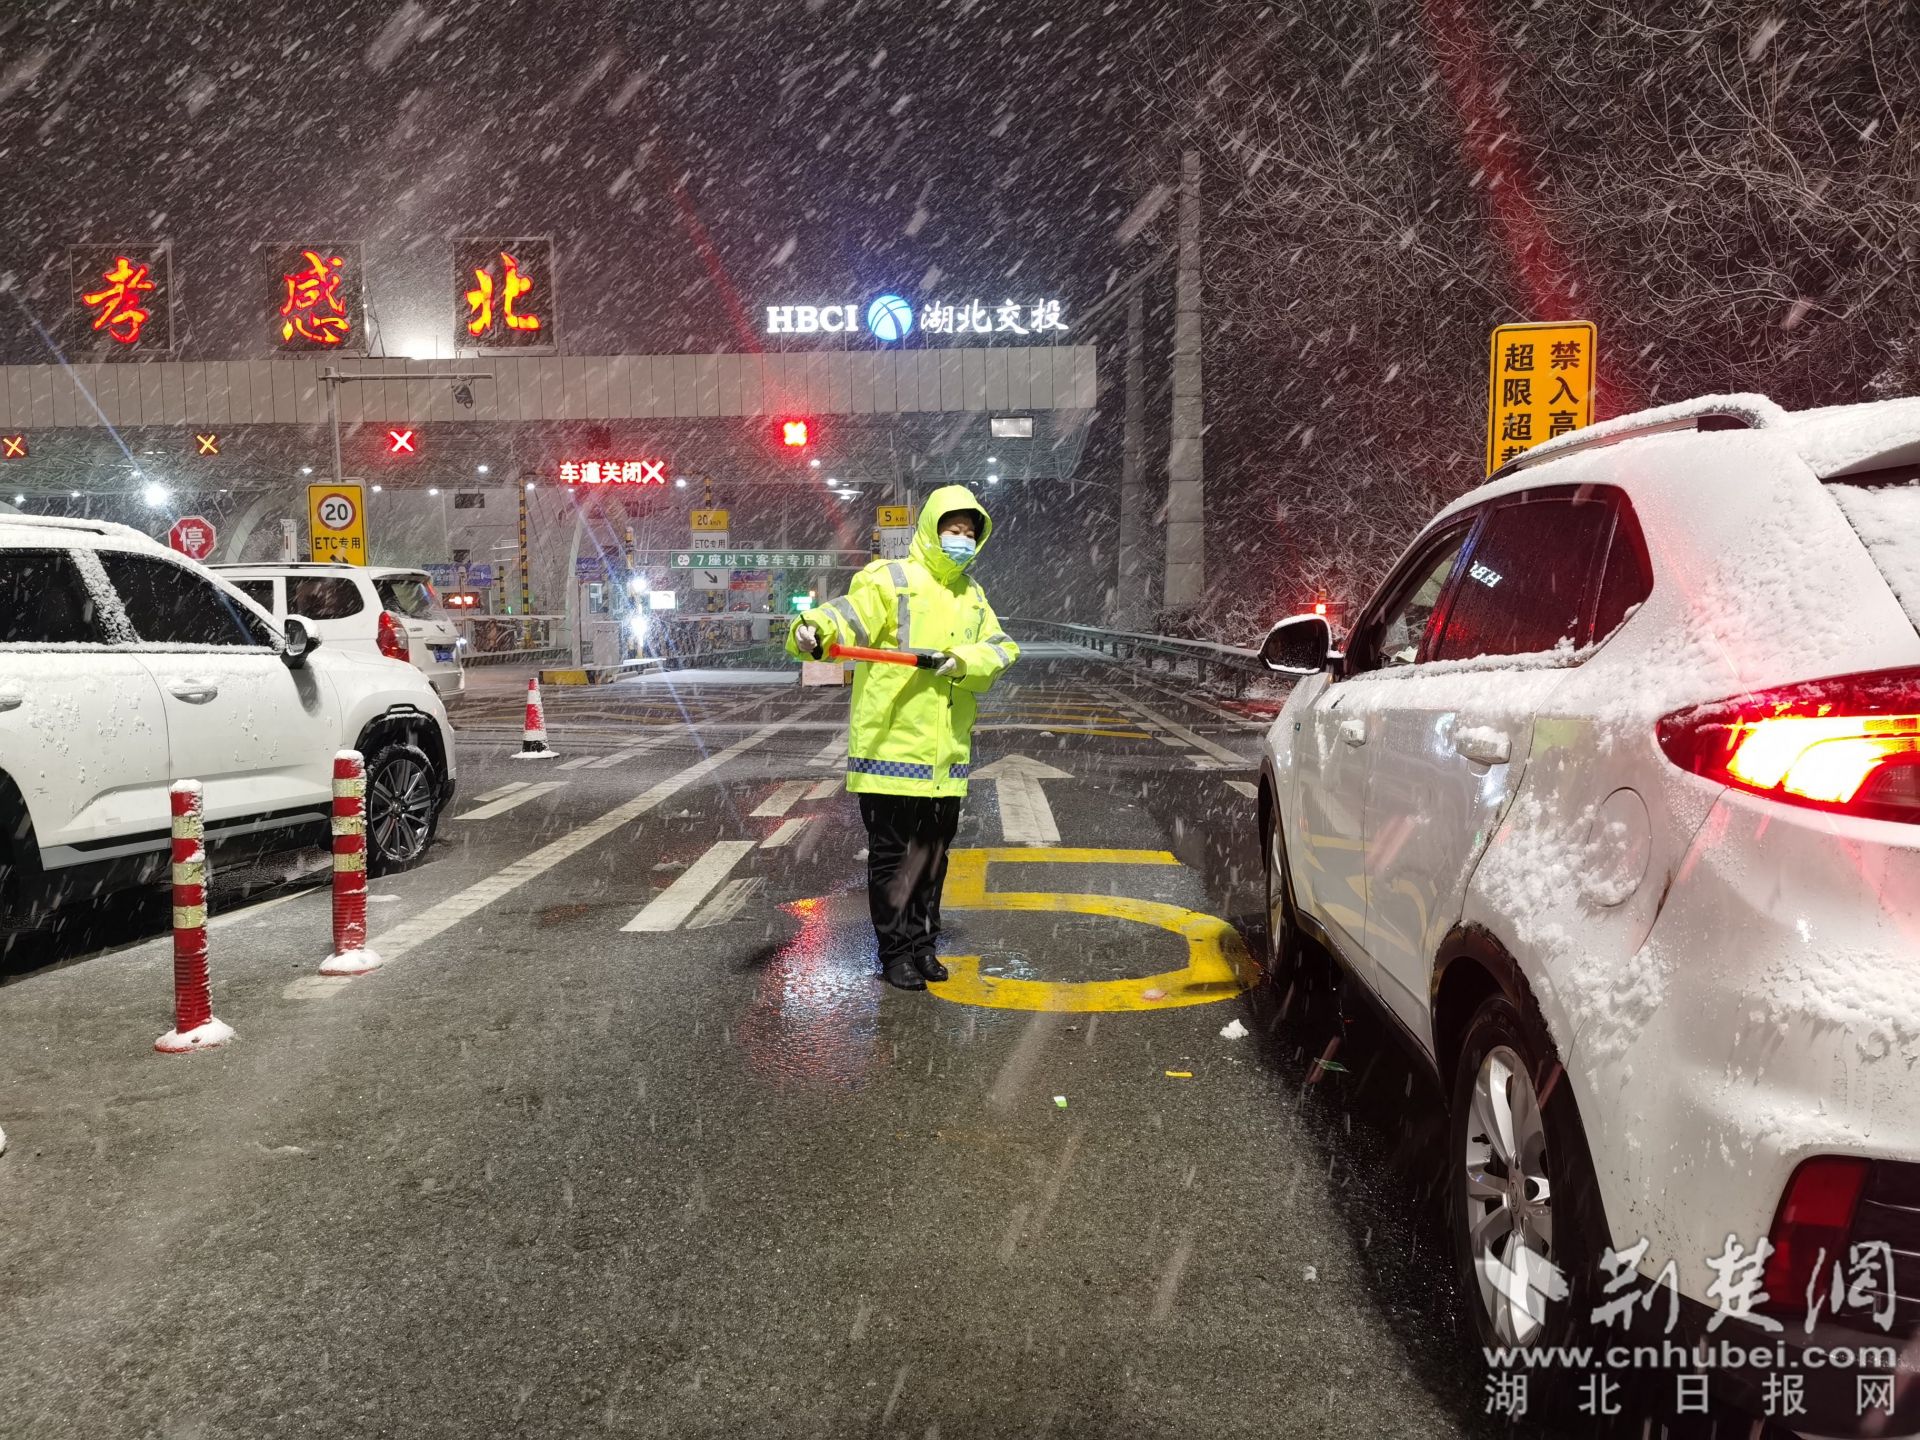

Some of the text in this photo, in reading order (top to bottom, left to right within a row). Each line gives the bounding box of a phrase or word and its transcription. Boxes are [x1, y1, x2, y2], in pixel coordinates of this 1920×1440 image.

[83, 250, 541, 344] 孝感北
[766, 304, 859, 334] HBCI
[920, 298, 1069, 335] 湖北交投
[325, 503, 349, 521] 20
[884, 511, 893, 522] 5
[179, 527, 206, 552] 停
[314, 536, 362, 550] ETC专用
